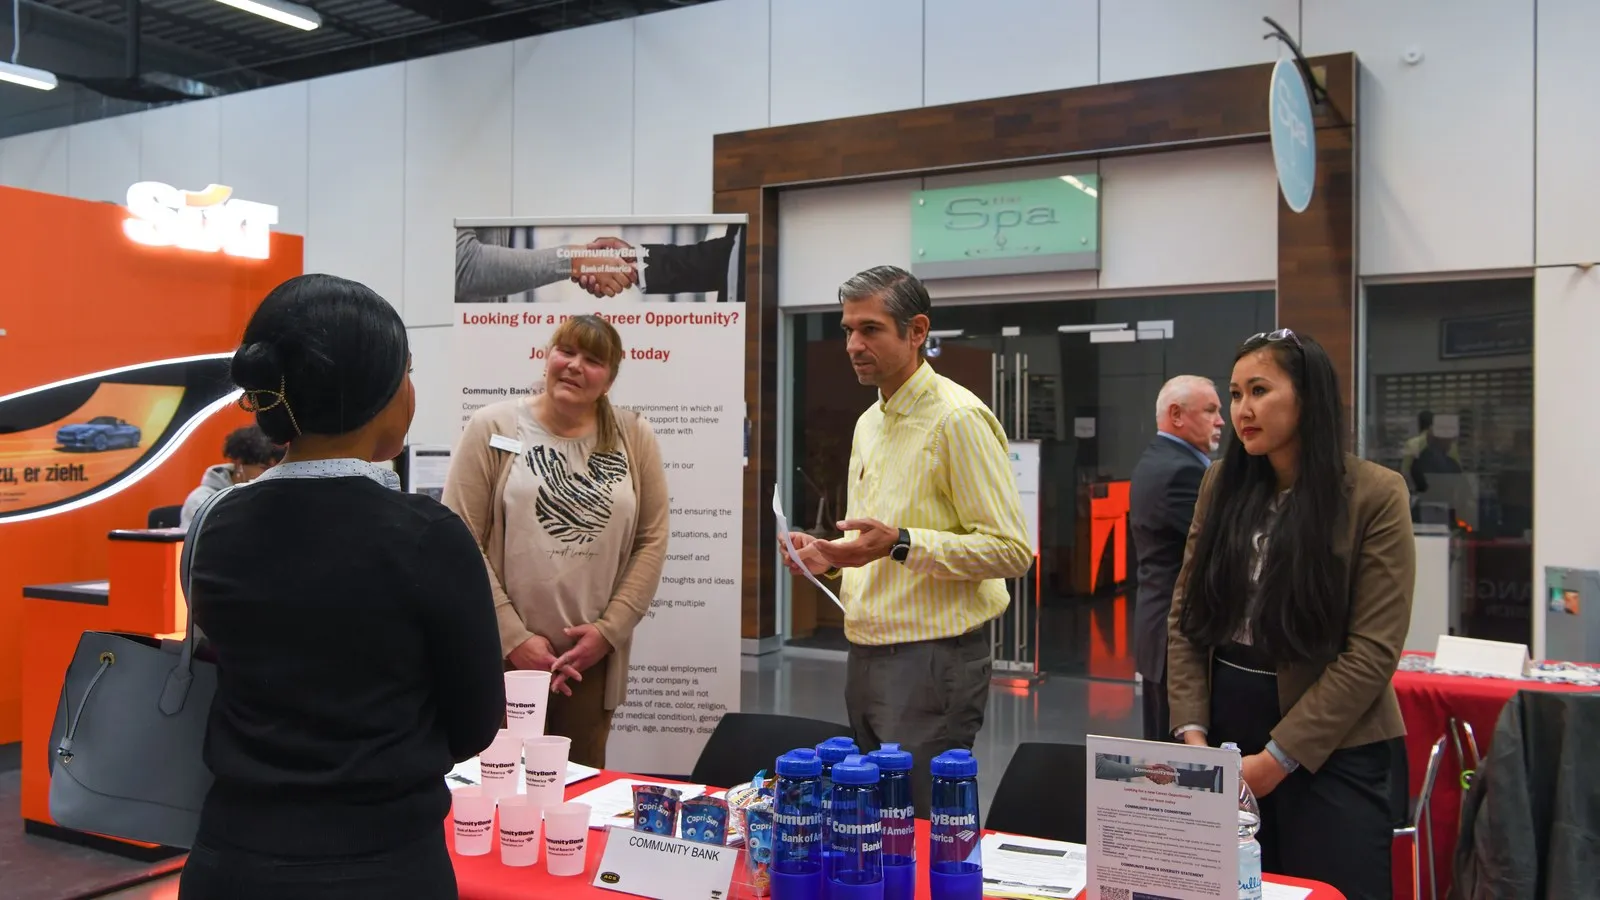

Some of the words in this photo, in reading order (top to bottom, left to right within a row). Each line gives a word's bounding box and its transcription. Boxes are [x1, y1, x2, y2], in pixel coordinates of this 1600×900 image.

[944, 198, 1060, 240] Spa
[556, 247, 650, 258] CommunityBak
[580, 264, 598, 273] Bank
[605, 264, 631, 273] America
[463, 312, 519, 327] Looking
[523, 312, 542, 324] for
[546, 315, 554, 324] a
[645, 312, 740, 327] Opportunity?
[631, 348, 670, 362] today
[462, 387, 507, 396] Community
[24, 466, 40, 482] er
[46, 463, 88, 482] zieht.
[684, 508, 718, 517] ensuring
[662, 576, 695, 585] thoughts
[651, 600, 673, 608] ggling
[671, 666, 717, 674] employment
[697, 703, 727, 711] religion,
[657, 713, 697, 722] condition),
[699, 715, 722, 723] gende
[617, 724, 640, 732] origin,
[661, 726, 695, 734] ancestry,
[686, 814, 719, 827] Capri-Sun
[930, 811, 975, 826] tyBank
[750, 822, 772, 832] Capri
[887, 825, 914, 835] Americ
[782, 832, 804, 842] Bank
[805, 833, 813, 842] of
[629, 836, 690, 856] COMMUNITY
[691, 847, 720, 861] BANK
